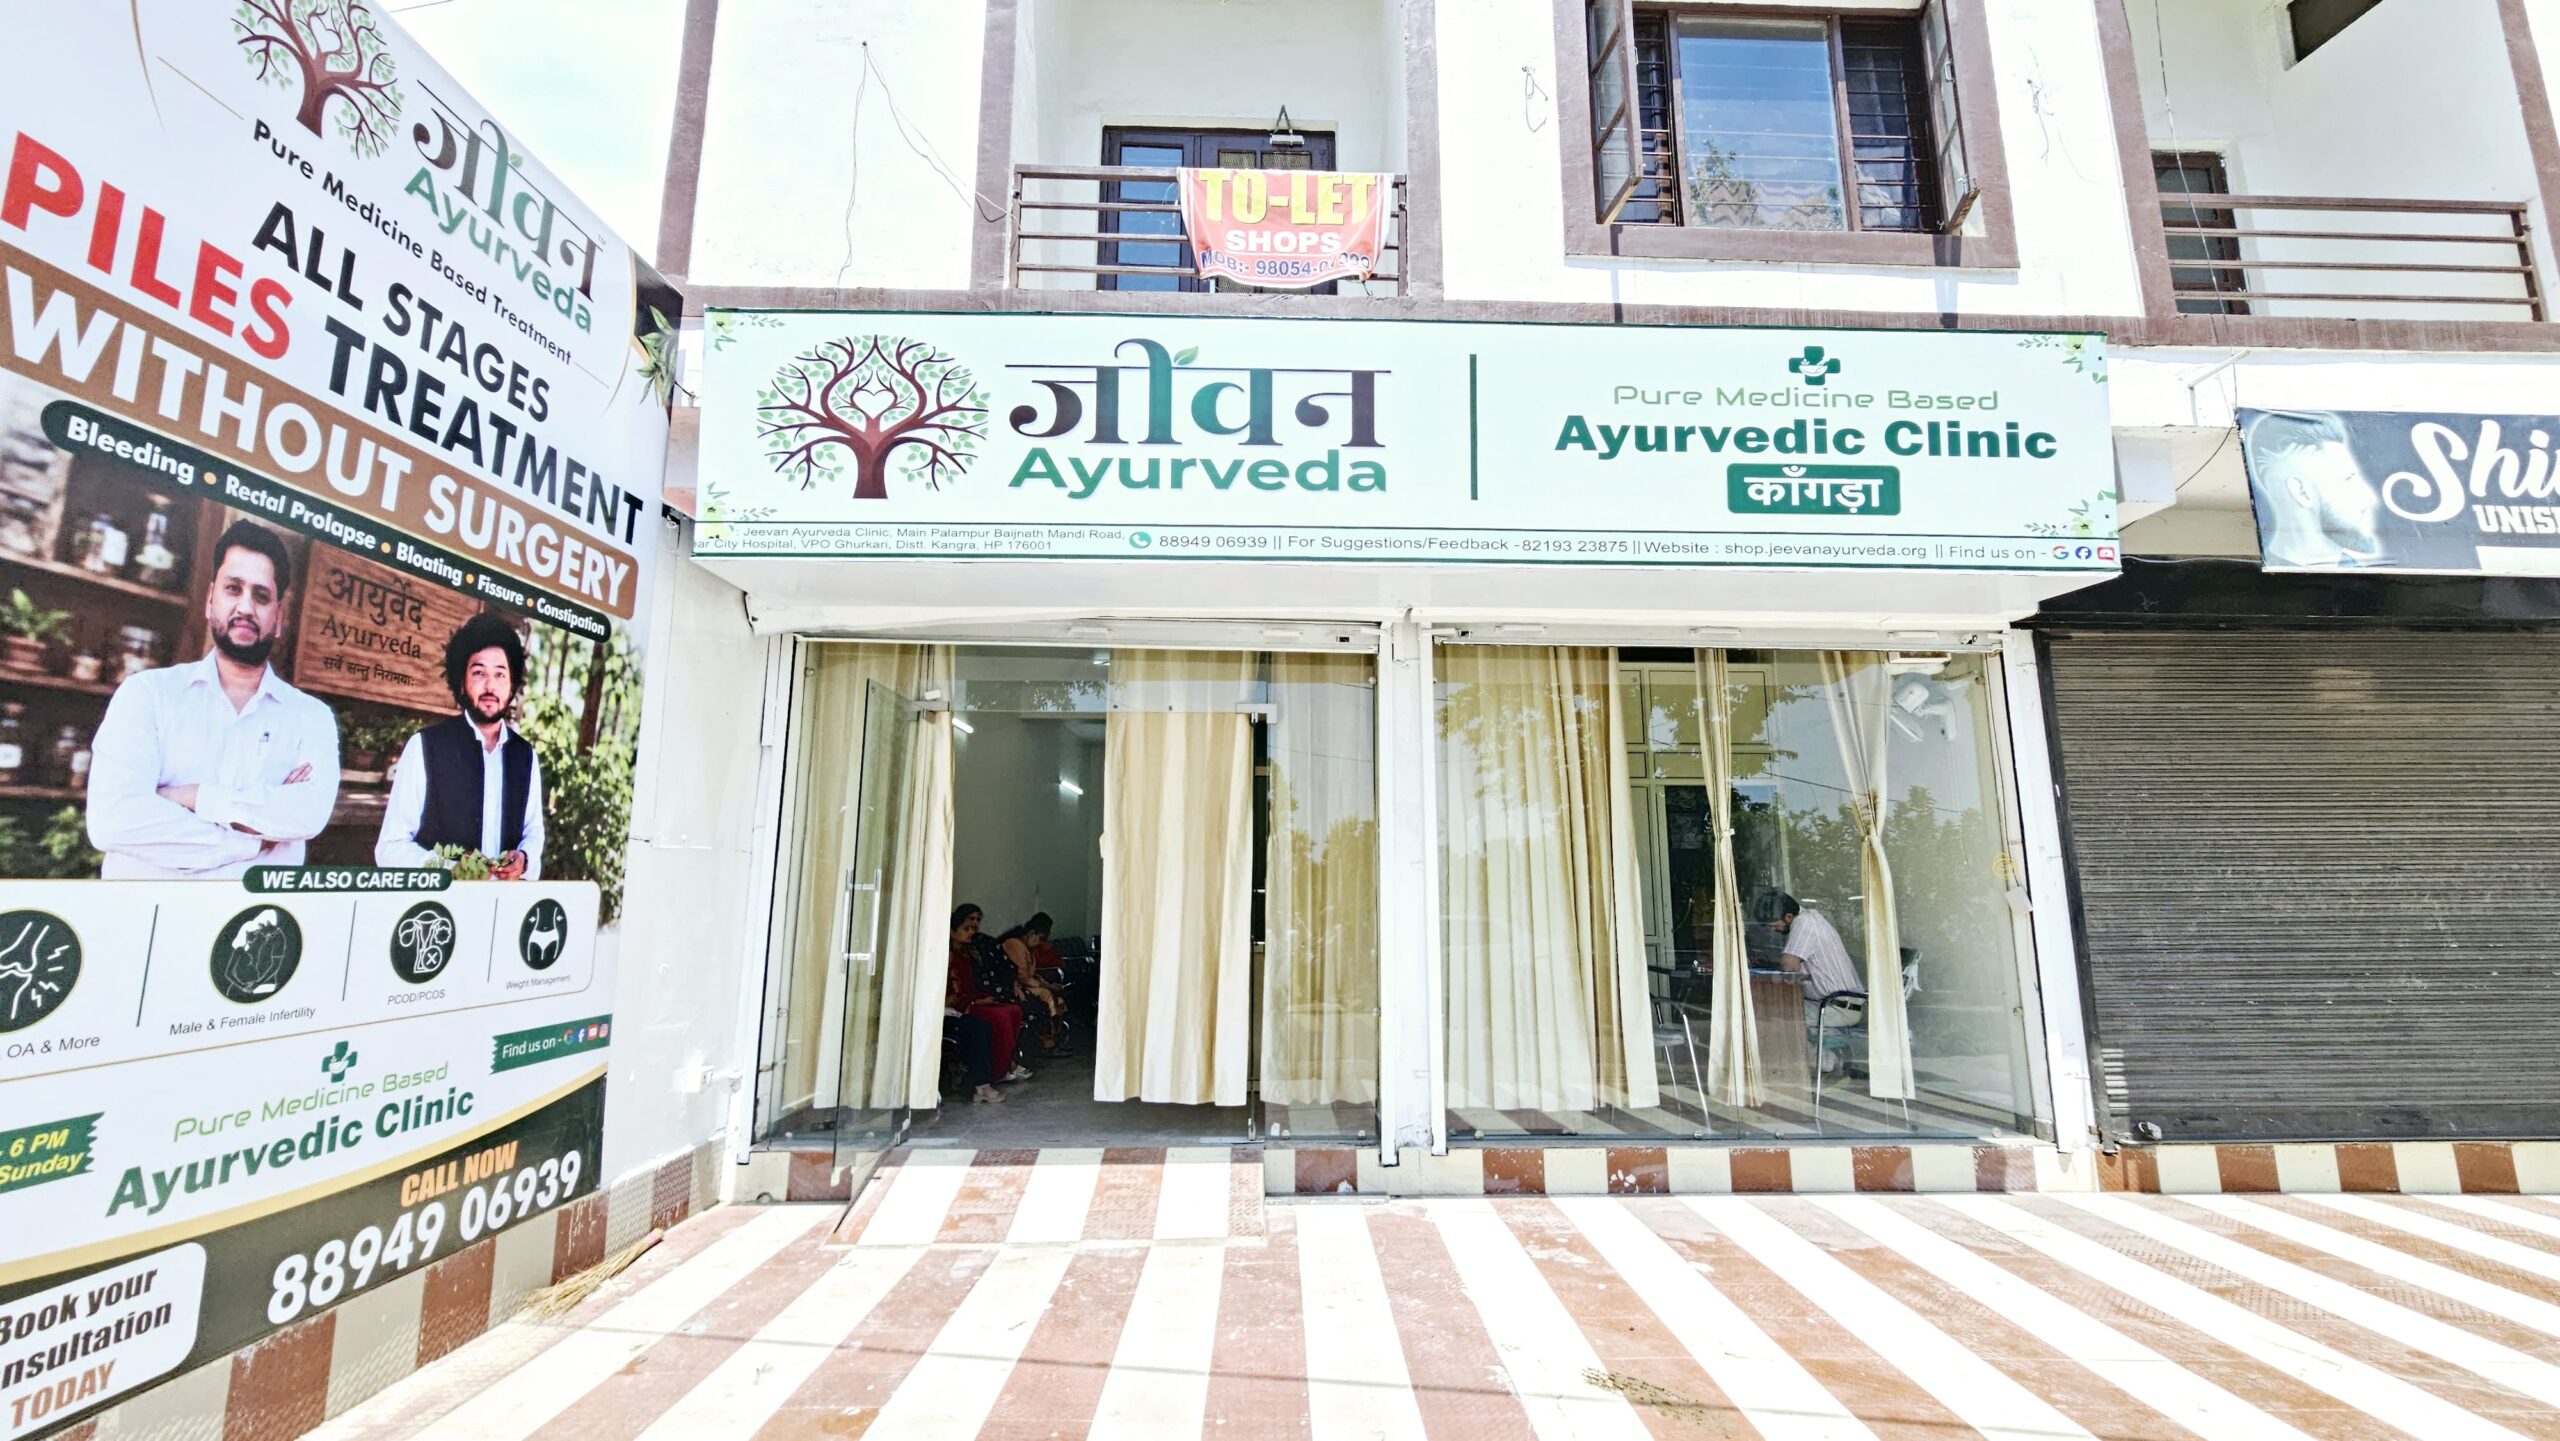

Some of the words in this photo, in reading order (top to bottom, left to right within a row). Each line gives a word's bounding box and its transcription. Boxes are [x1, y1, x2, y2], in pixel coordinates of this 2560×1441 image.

[413, 80, 603, 302] जीवन
[1200, 169, 1377, 225] TO-LET
[0, 130, 294, 361] PILES
[254, 118, 314, 180] Pure
[322, 171, 424, 260] Medicine
[430, 249, 487, 305] Based
[492, 296, 573, 366] Treatment
[404, 166, 592, 335] Ayurveda
[1225, 230, 1341, 253] SHOPS
[251, 200, 363, 312] ALL
[382, 282, 549, 423] STAGES
[1004, 337, 1392, 448] जीवन
[1613, 384, 1702, 407] Pure
[1716, 386, 1874, 410] Medicine
[1888, 389, 1998, 412] Based
[4, 265, 412, 513] WITHOUT
[423, 474, 629, 607] SURGERY
[323, 315, 643, 546] TREATMENT
[1555, 414, 1866, 460] Ayurvedic
[1884, 421, 2058, 459] Clinic
[1008, 446, 1387, 500] Ayurveda
[1744, 464, 1882, 513] काँगड़ा
[66, 414, 195, 485] Bleeding
[224, 473, 286, 514] Rectal
[290, 500, 376, 550] Prolapse
[396, 541, 463, 587] Bloating
[477, 574, 524, 606] Fissure
[536, 597, 605, 636] Constipation
[743, 527, 788, 537] Jeevan
[792, 527, 850, 538] Ayurveda
[855, 527, 892, 538] Clinic,
[897, 528, 926, 537] Main
[931, 528, 990, 541] Palampur
[994, 528, 1043, 540] Baijnath
[1048, 529, 1085, 538] Mandi
[2472, 504, 2560, 534] UNIS
[714, 539, 738, 550] City
[743, 539, 796, 550] Hospital,
[801, 540, 830, 549] VPO
[984, 541, 1003, 549] HP
[1008, 541, 1051, 550] 176001
[1159, 535, 1211, 549] 88949
[1216, 535, 1268, 549] 06939
[1288, 536, 1316, 550] For
[1321, 536, 1508, 554] Suggestions/Feedback
[1577, 539, 1629, 553] 23875
[1645, 540, 1709, 554] Website
[1725, 542, 1928, 561] shop.jeevanayurveda.org
[1949, 545, 1986, 559] Find
[1993, 549, 2011, 559] us
[2015, 549, 2035, 560] on
[326, 566, 427, 631] आयुर्वेद
[320, 614, 421, 659] Ayurveda
[261, 869, 296, 890] WE
[299, 869, 352, 890] ALSO
[356, 869, 404, 890] CARE
[408, 869, 441, 890] FOR
[387, 988, 446, 1006] PCOD/PCOS
[505, 977, 530, 990] Weight
[169, 1022, 203, 1036] Male
[206, 1018, 216, 1031] &
[220, 1012, 266, 1030] Female
[269, 1005, 316, 1023] Infertility
[7, 1043, 35, 1058] OA
[40, 1039, 52, 1054] &
[59, 1036, 100, 1052] More
[502, 1038, 527, 1059] Find
[528, 1041, 541, 1053] us
[543, 1038, 556, 1050] on
[174, 1106, 250, 1142] Pure
[261, 1078, 374, 1124] Medicine
[383, 1061, 448, 1096] Based
[9, 1137, 26, 1158] 6
[29, 1128, 70, 1154] PM
[105, 1118, 362, 1217] Ayurvedic
[376, 1086, 474, 1138] Clinic
[0, 1152, 86, 1185] Sunday
[400, 1155, 459, 1209] CALL
[463, 1140, 518, 1185] NOW
[267, 1202, 444, 1325] 88949
[459, 1150, 582, 1243] 06939
[86, 1268, 158, 1318] your
[11, 1359, 117, 1429] TODAY
